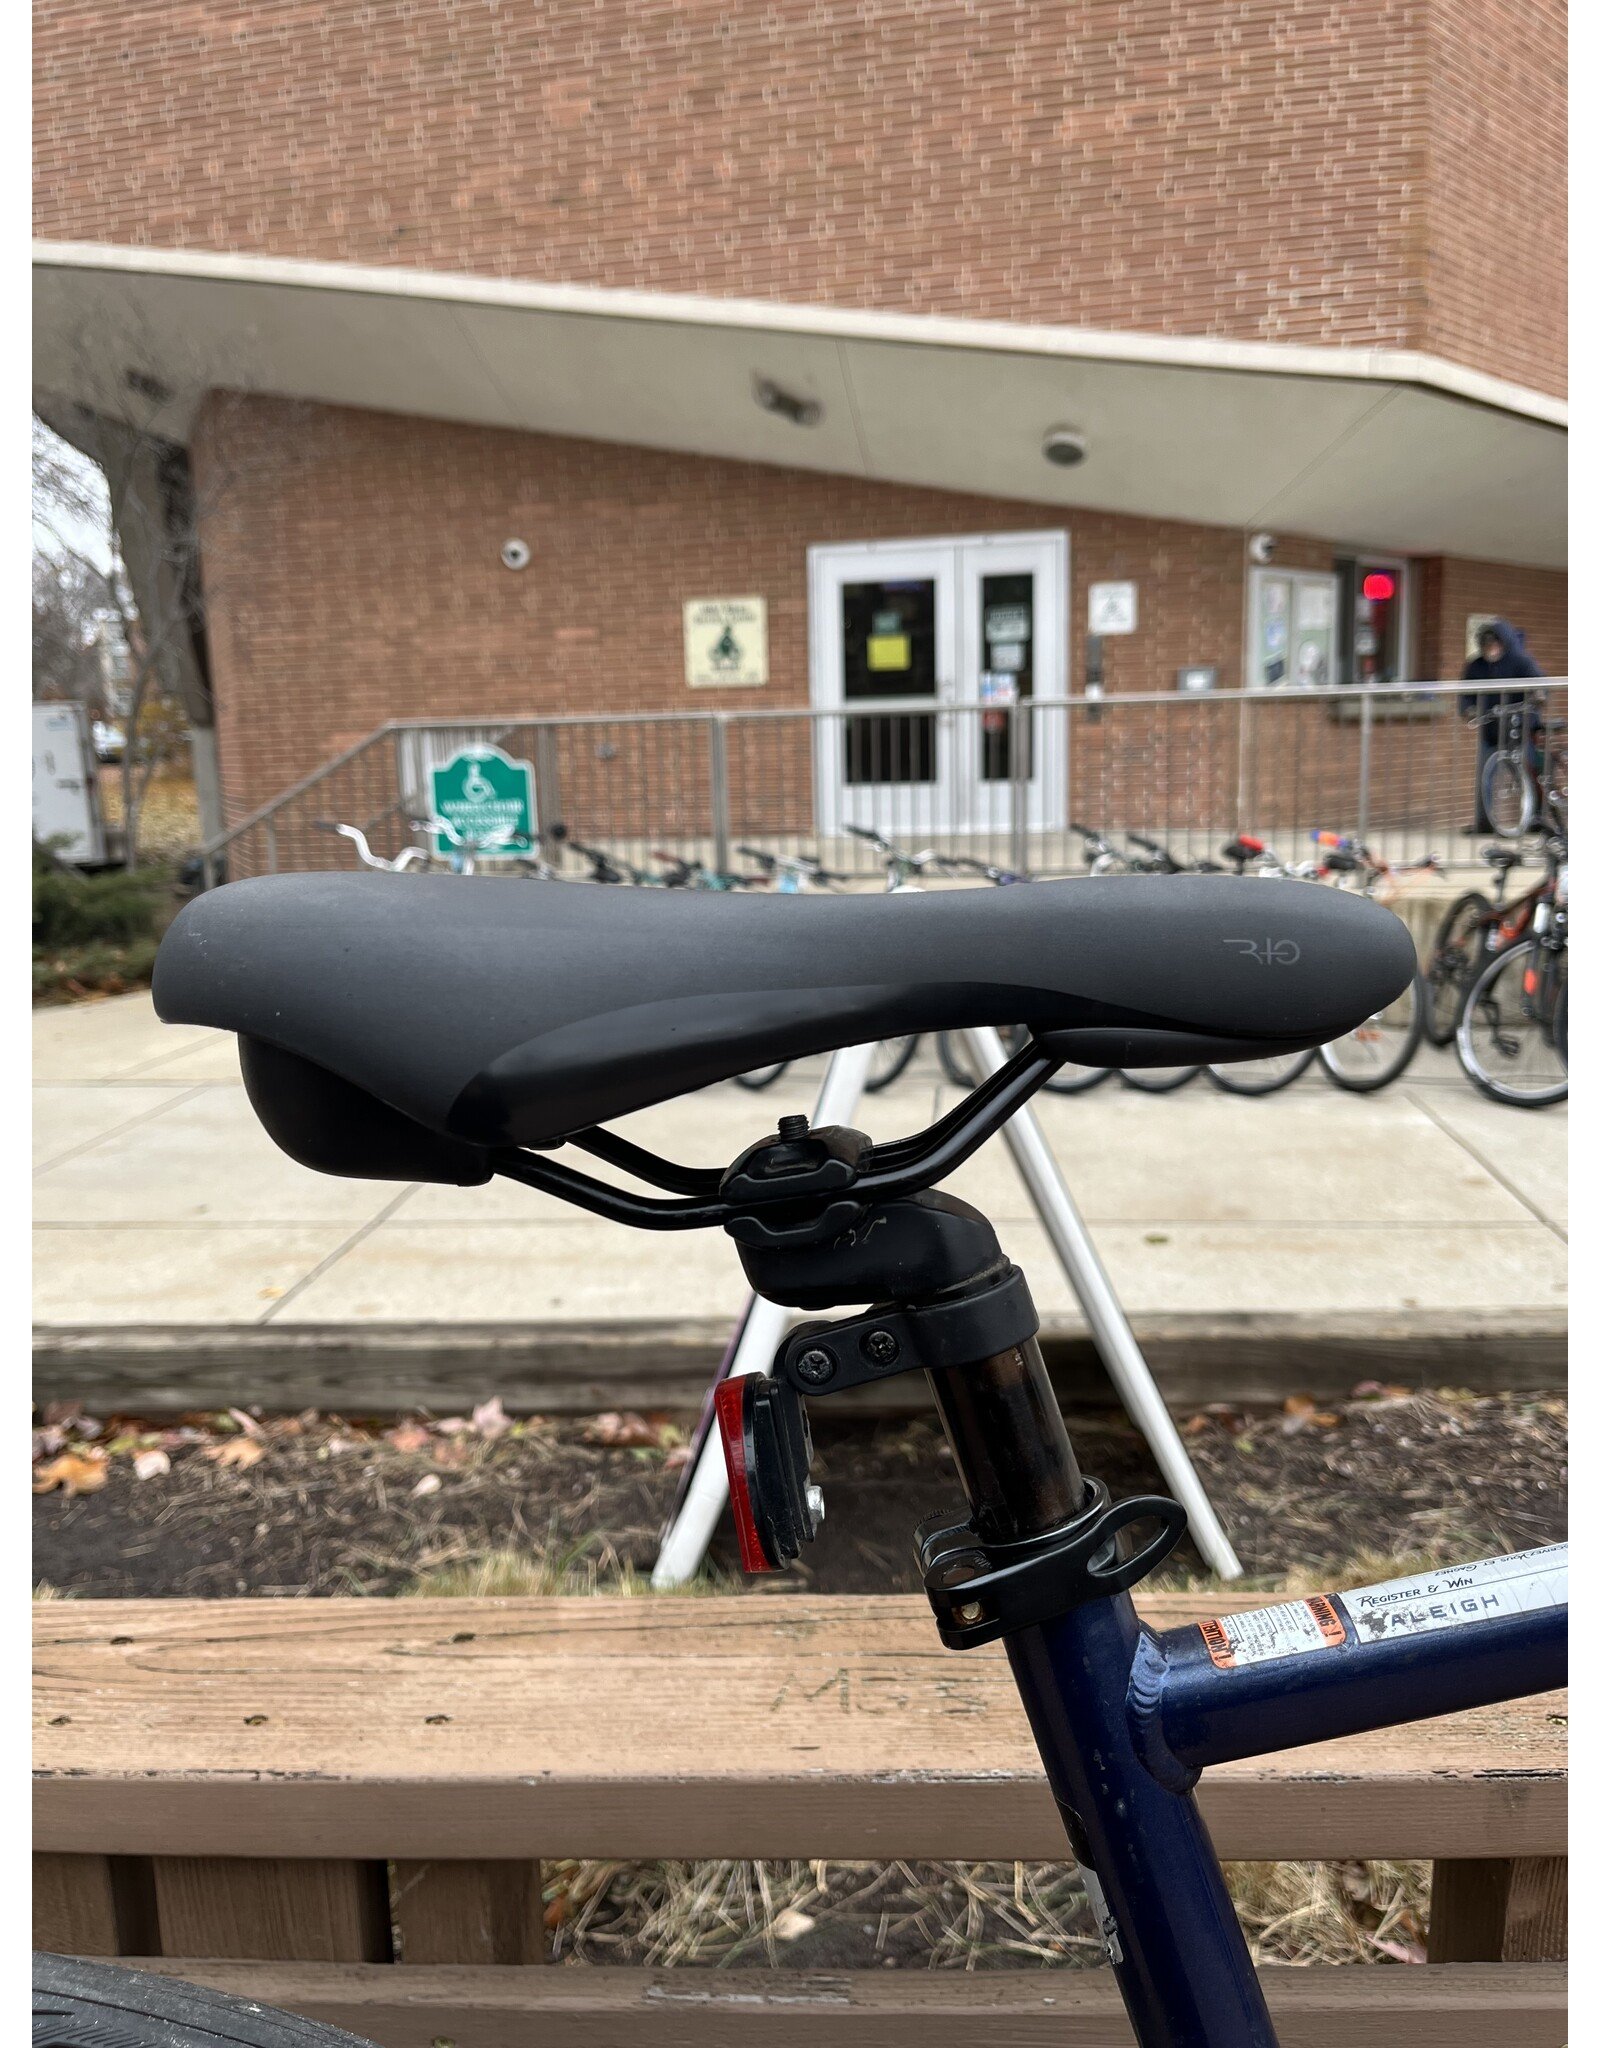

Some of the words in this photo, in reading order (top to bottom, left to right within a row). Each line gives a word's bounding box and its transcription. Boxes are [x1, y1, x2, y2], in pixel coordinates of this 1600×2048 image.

[1356, 1588, 1421, 1608] REGISTER
[1427, 1584, 1439, 1593] &
[1390, 1594, 1500, 1628] ALEIGH
